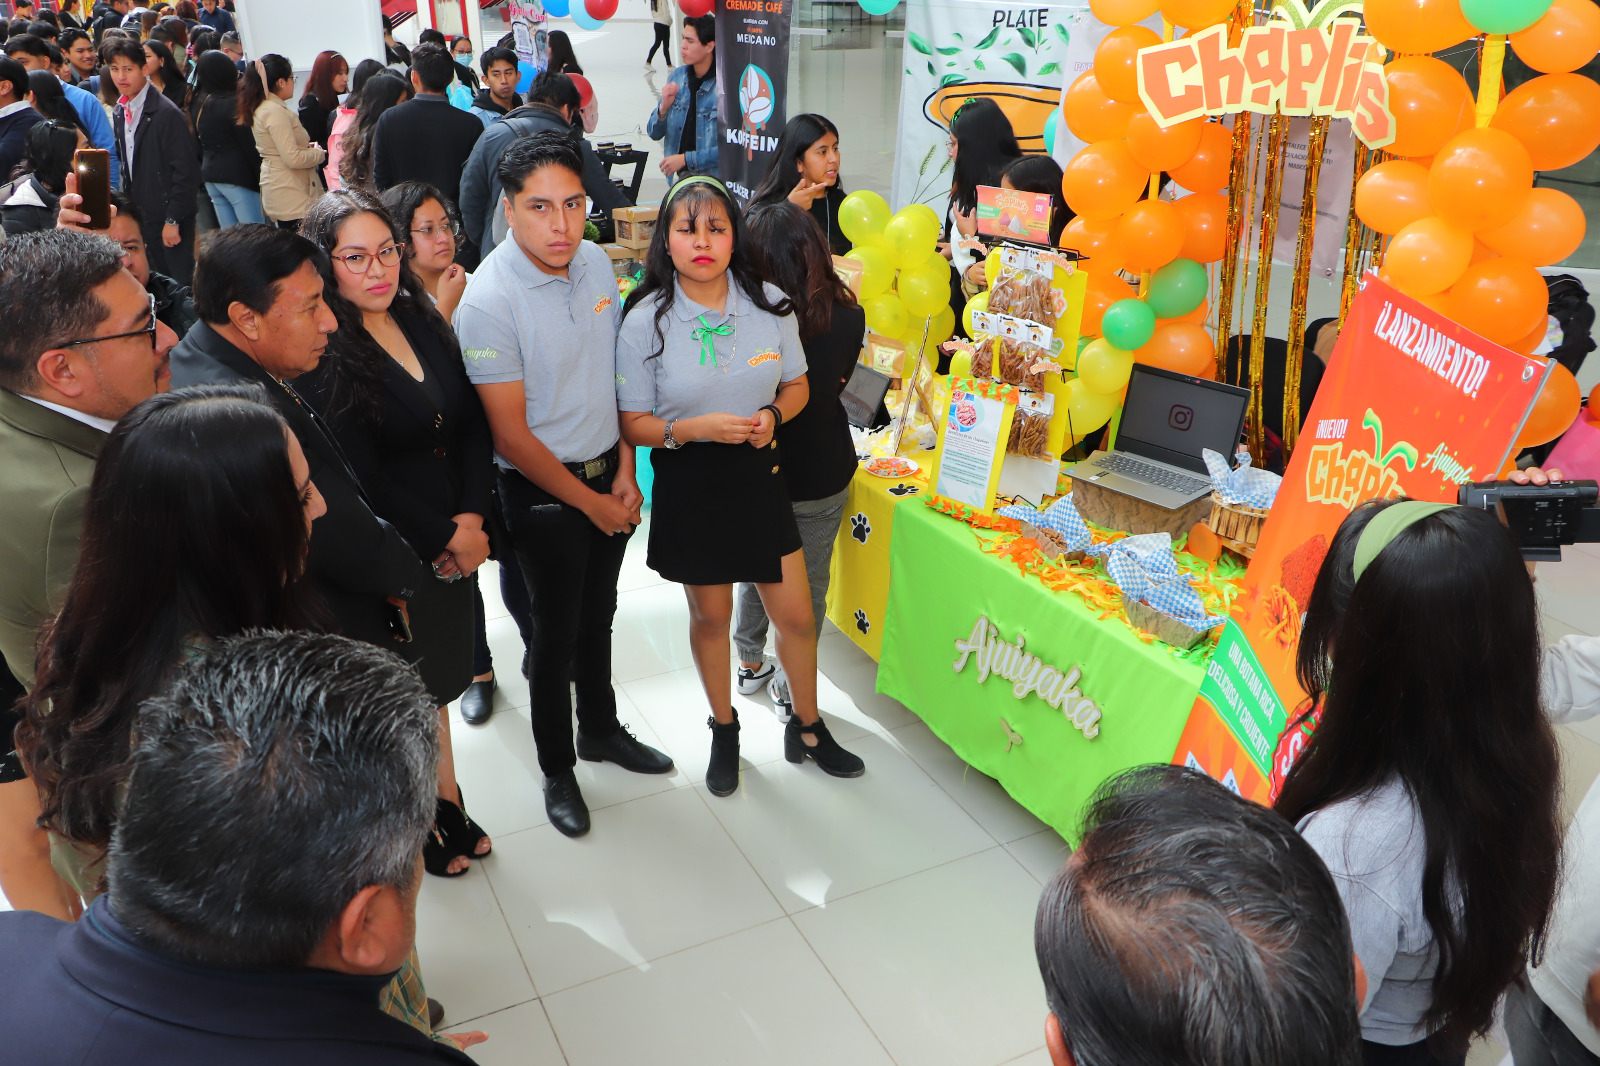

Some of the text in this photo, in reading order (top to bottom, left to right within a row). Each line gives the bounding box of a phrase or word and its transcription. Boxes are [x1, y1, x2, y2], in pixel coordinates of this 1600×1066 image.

[765, 0, 783, 14] CAFÉ
[992, 8, 1049, 28] PLATE
[726, 128, 779, 153] KOFFEIN
[1373, 300, 1490, 399] ¡LANZAMIENTO!
[1315, 419, 1349, 439] ¡NUEVO!
[1421, 442, 1474, 485] Ajuiyak
[953, 615, 1102, 740] Ajuiyaka
[1228, 640, 1276, 726] UNA BOTANA RICA,
[1207, 659, 1271, 763] DELICIOSA Y CRUJIENTE
